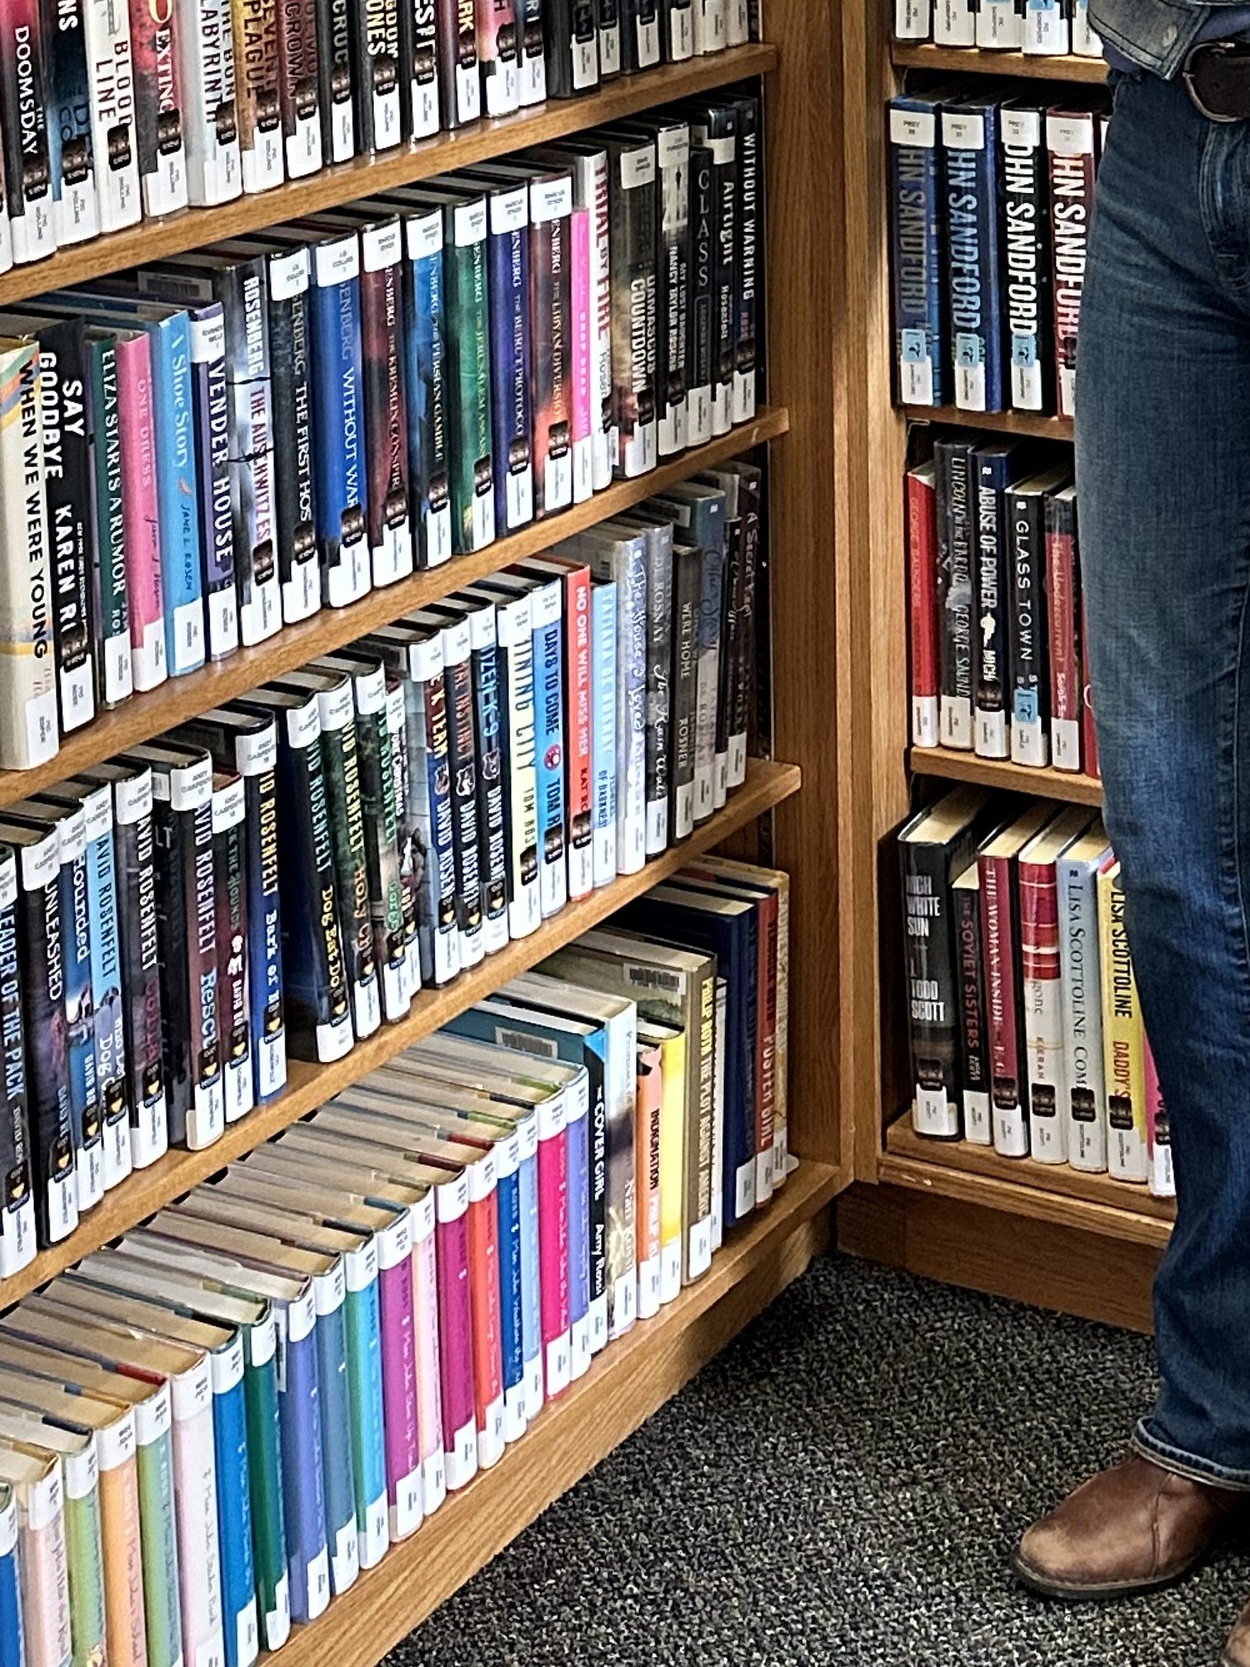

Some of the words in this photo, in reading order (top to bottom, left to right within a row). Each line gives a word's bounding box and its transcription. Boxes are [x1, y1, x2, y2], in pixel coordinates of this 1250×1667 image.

[15, 27, 39, 154] DOOMSDAY
[96, 60, 114, 121] LINE
[114, 41, 132, 127] BLOOD
[1007, 202, 1036, 335] SANDFORD
[19, 361, 36, 439] WHEN
[40, 353, 61, 478] GOODBYE
[62, 380, 83, 436] SAY
[22, 445, 37, 482] WE
[25, 489, 42, 563] WERE
[979, 486, 995, 532] ABUSE
[54, 505, 75, 592] KAREN
[980, 536, 995, 554] OF
[1016, 521, 1032, 589] GLASS
[31, 569, 47, 658] YOUNG
[980, 558, 997, 608] POWER
[1018, 599, 1034, 660] TOWN
[259, 801, 279, 897] ROSENFELT
[1110, 892, 1130, 925] LISA
[1112, 929, 1133, 1018] SCOTTOLINE
[5, 1052, 22, 1099] PACK
